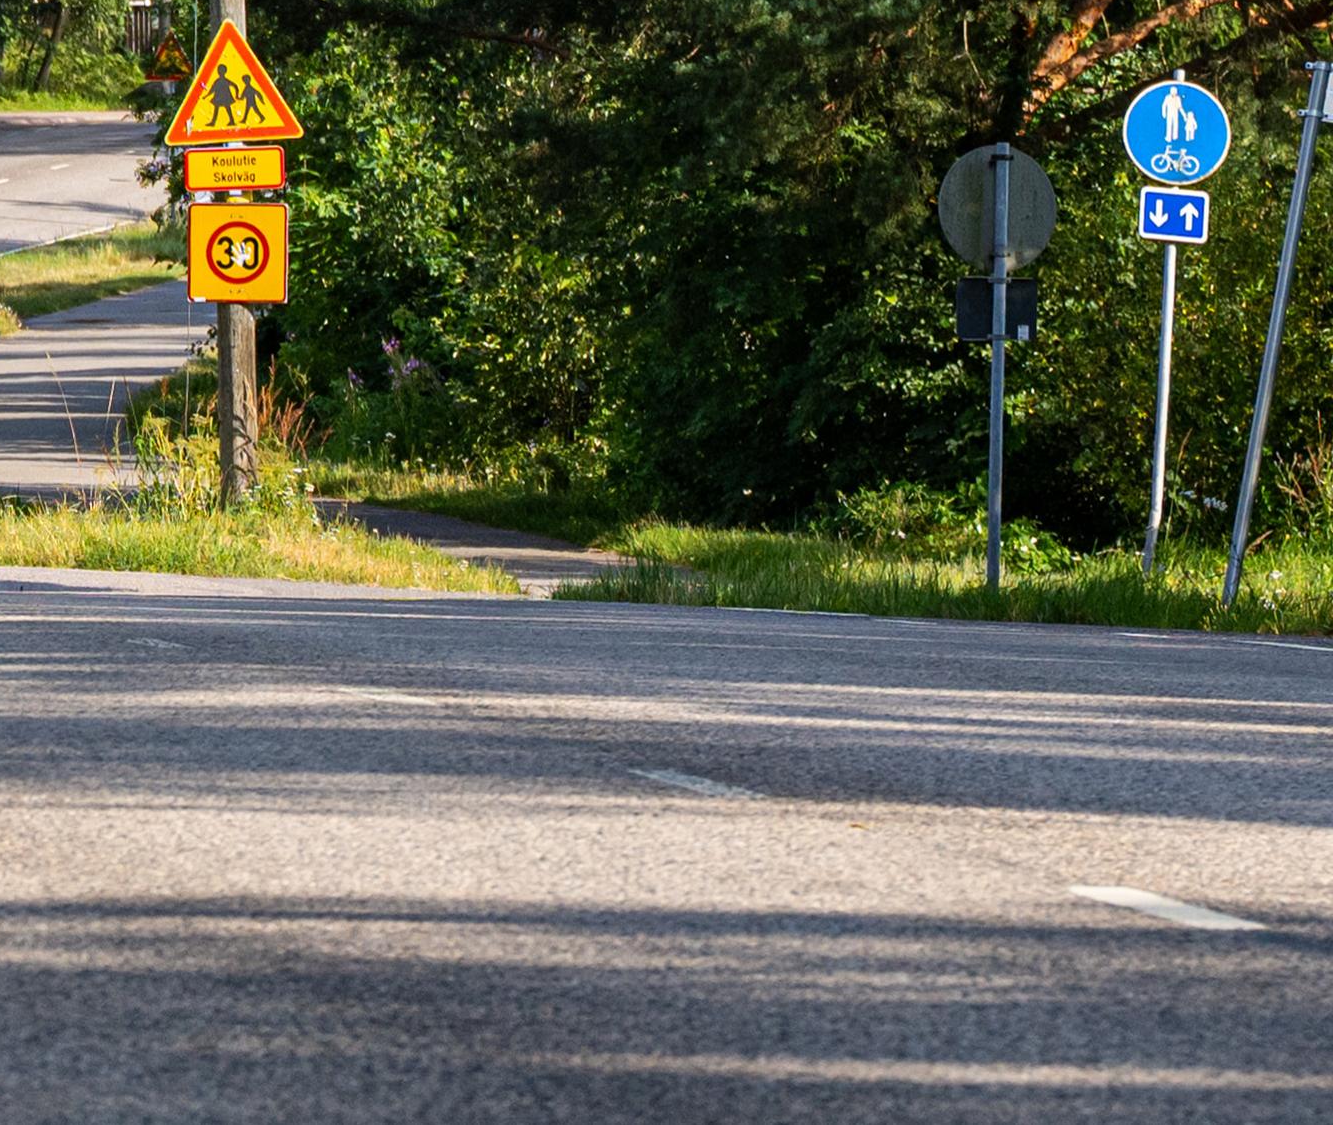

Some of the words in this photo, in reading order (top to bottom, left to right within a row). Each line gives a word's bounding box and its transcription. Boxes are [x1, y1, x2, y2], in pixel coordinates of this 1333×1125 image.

[211, 156, 257, 167] Koulutie
[213, 172, 256, 183] Skolväg
[216, 236, 259, 270] 30
